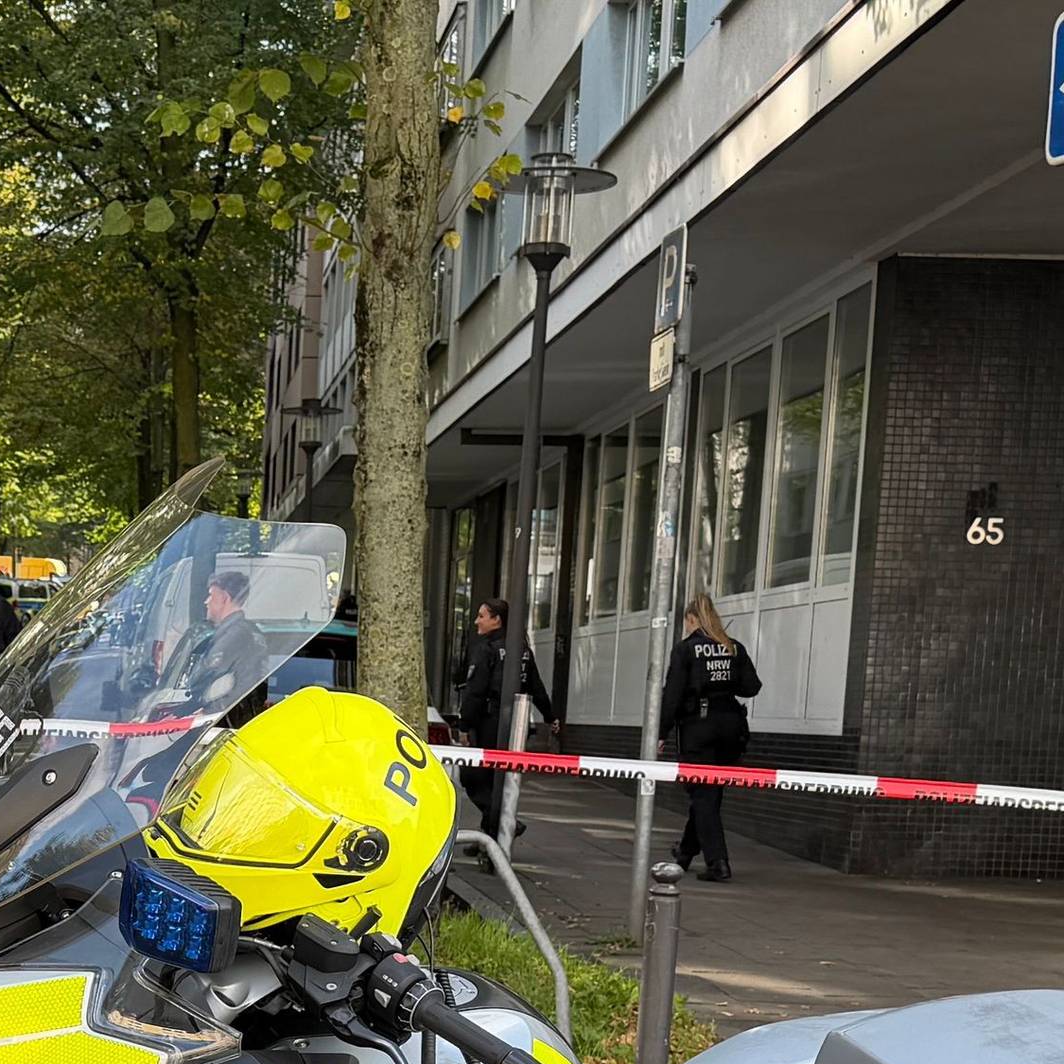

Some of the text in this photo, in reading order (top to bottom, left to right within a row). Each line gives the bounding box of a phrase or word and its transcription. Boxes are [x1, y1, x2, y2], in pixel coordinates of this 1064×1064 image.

[661, 245, 677, 317] P
[967, 517, 1004, 545] 65
[694, 643, 737, 658] POLIZI
[706, 659, 731, 670] NRW
[710, 671, 731, 681] 2821
[384, 718, 427, 807] PO
